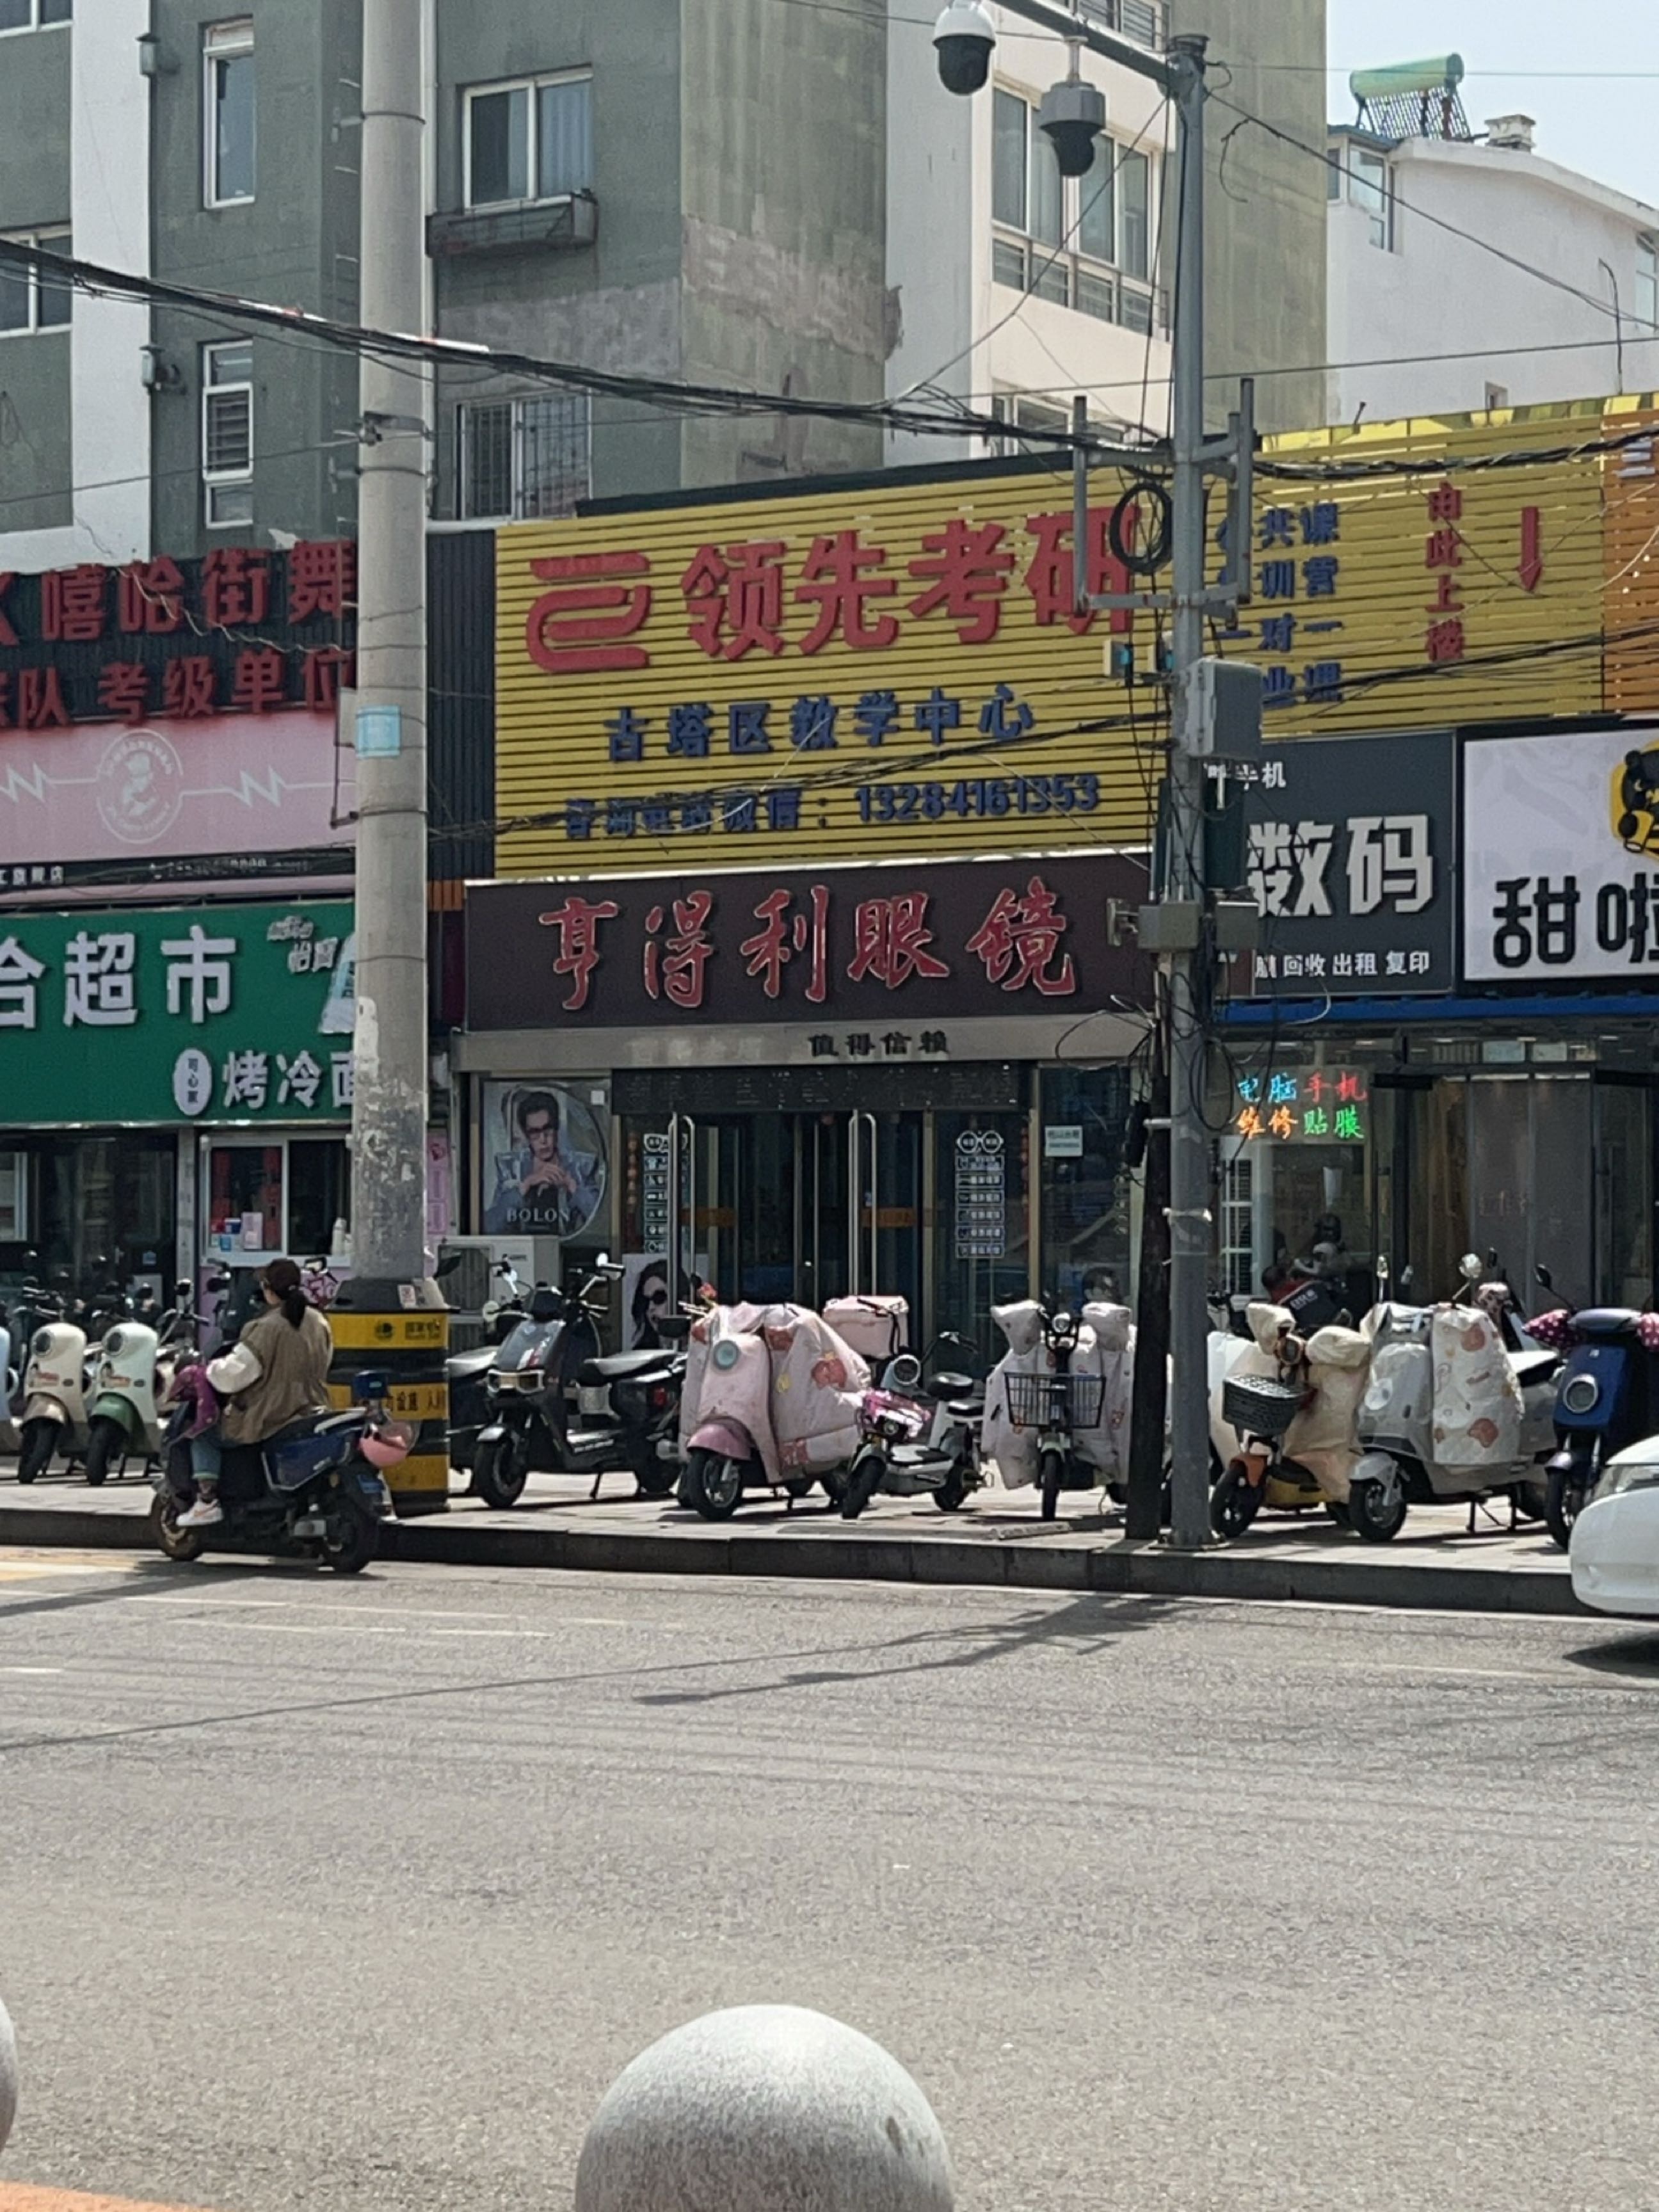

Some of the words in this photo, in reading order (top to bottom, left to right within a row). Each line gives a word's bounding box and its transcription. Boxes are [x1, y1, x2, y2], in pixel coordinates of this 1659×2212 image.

[1215, 503, 1340, 549] 共课
[681, 504, 1141, 661] 领先考研
[1217, 556, 1338, 599] 训营
[603, 682, 1034, 763] 古塔区教学中心
[1247, 814, 1434, 918] 数码
[538, 876, 1077, 1010] 亨得利眼镜
[1238, 1070, 1368, 1103] 电脑手机
[1235, 1104, 1365, 1141] 维修贴膜
